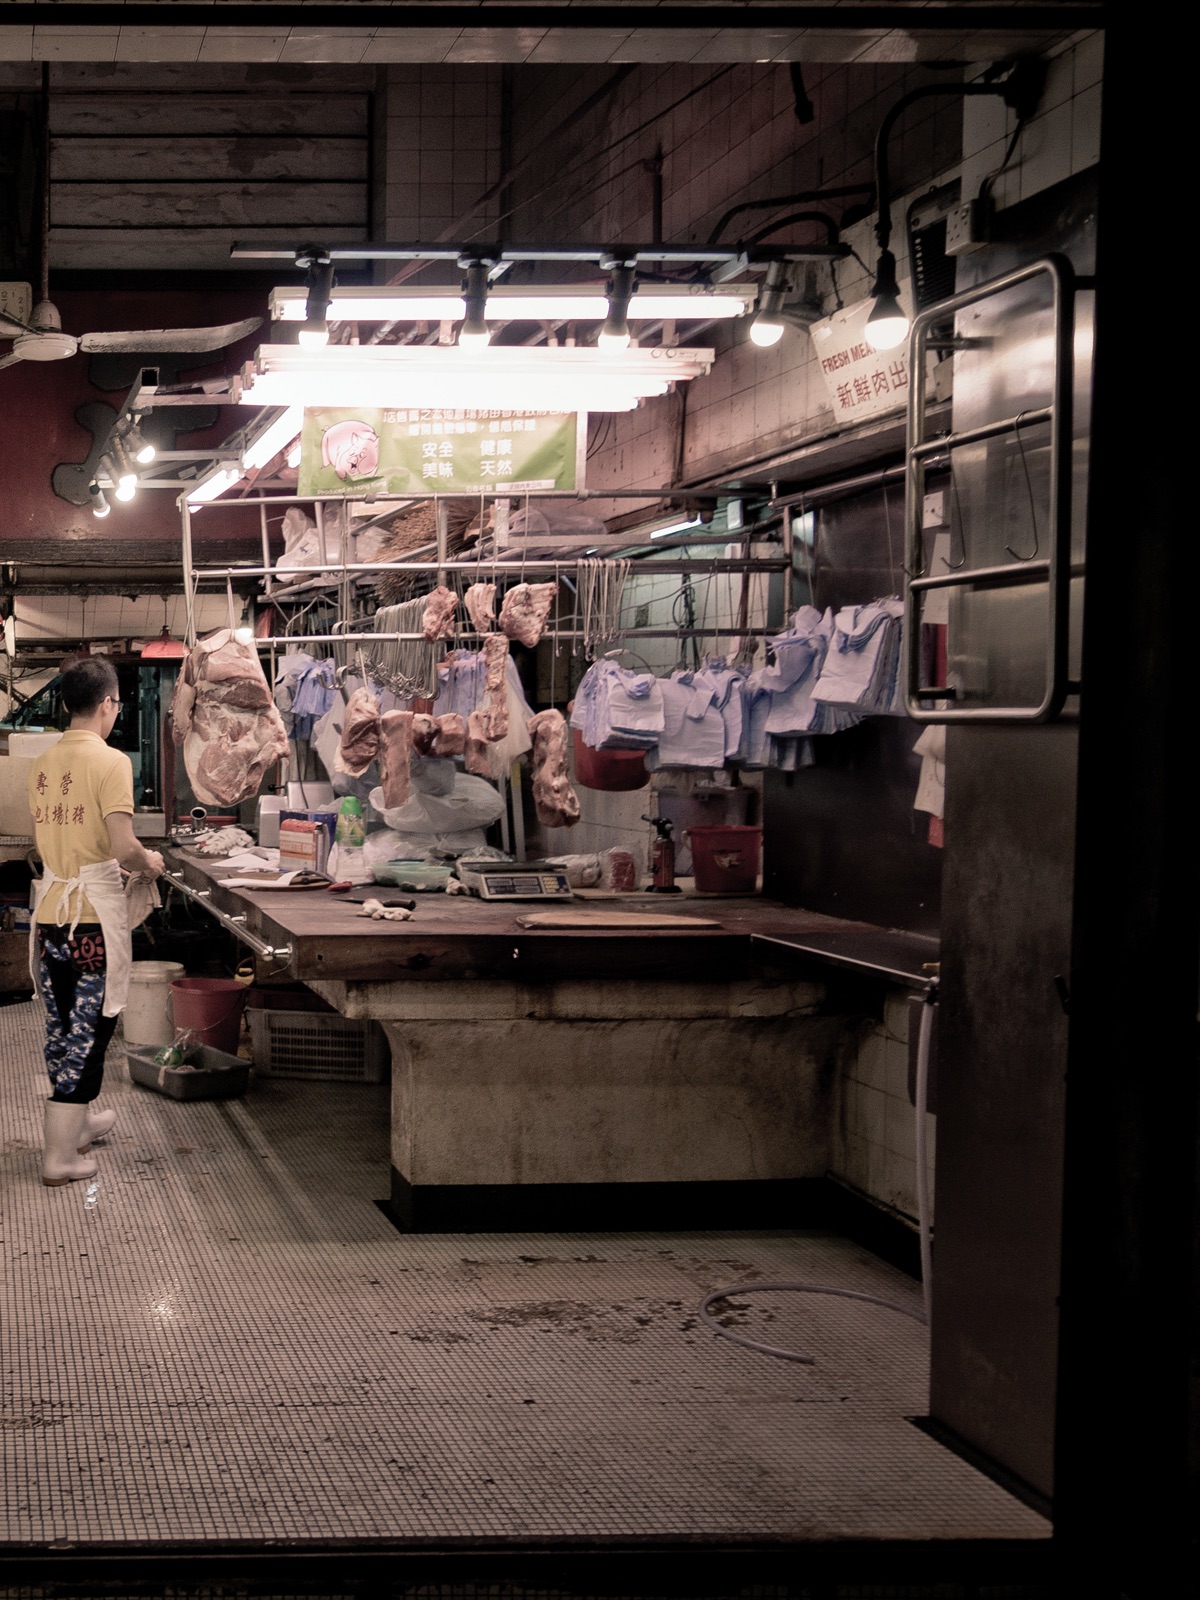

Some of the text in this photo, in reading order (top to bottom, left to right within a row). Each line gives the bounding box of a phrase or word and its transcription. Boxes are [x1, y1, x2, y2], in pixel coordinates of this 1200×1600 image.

[821, 341, 877, 375] FRESH MEA
[836, 360, 912, 409] 新鮮肉出
[421, 439, 513, 460] 安全 健康
[422, 459, 513, 479] 美味 天然
